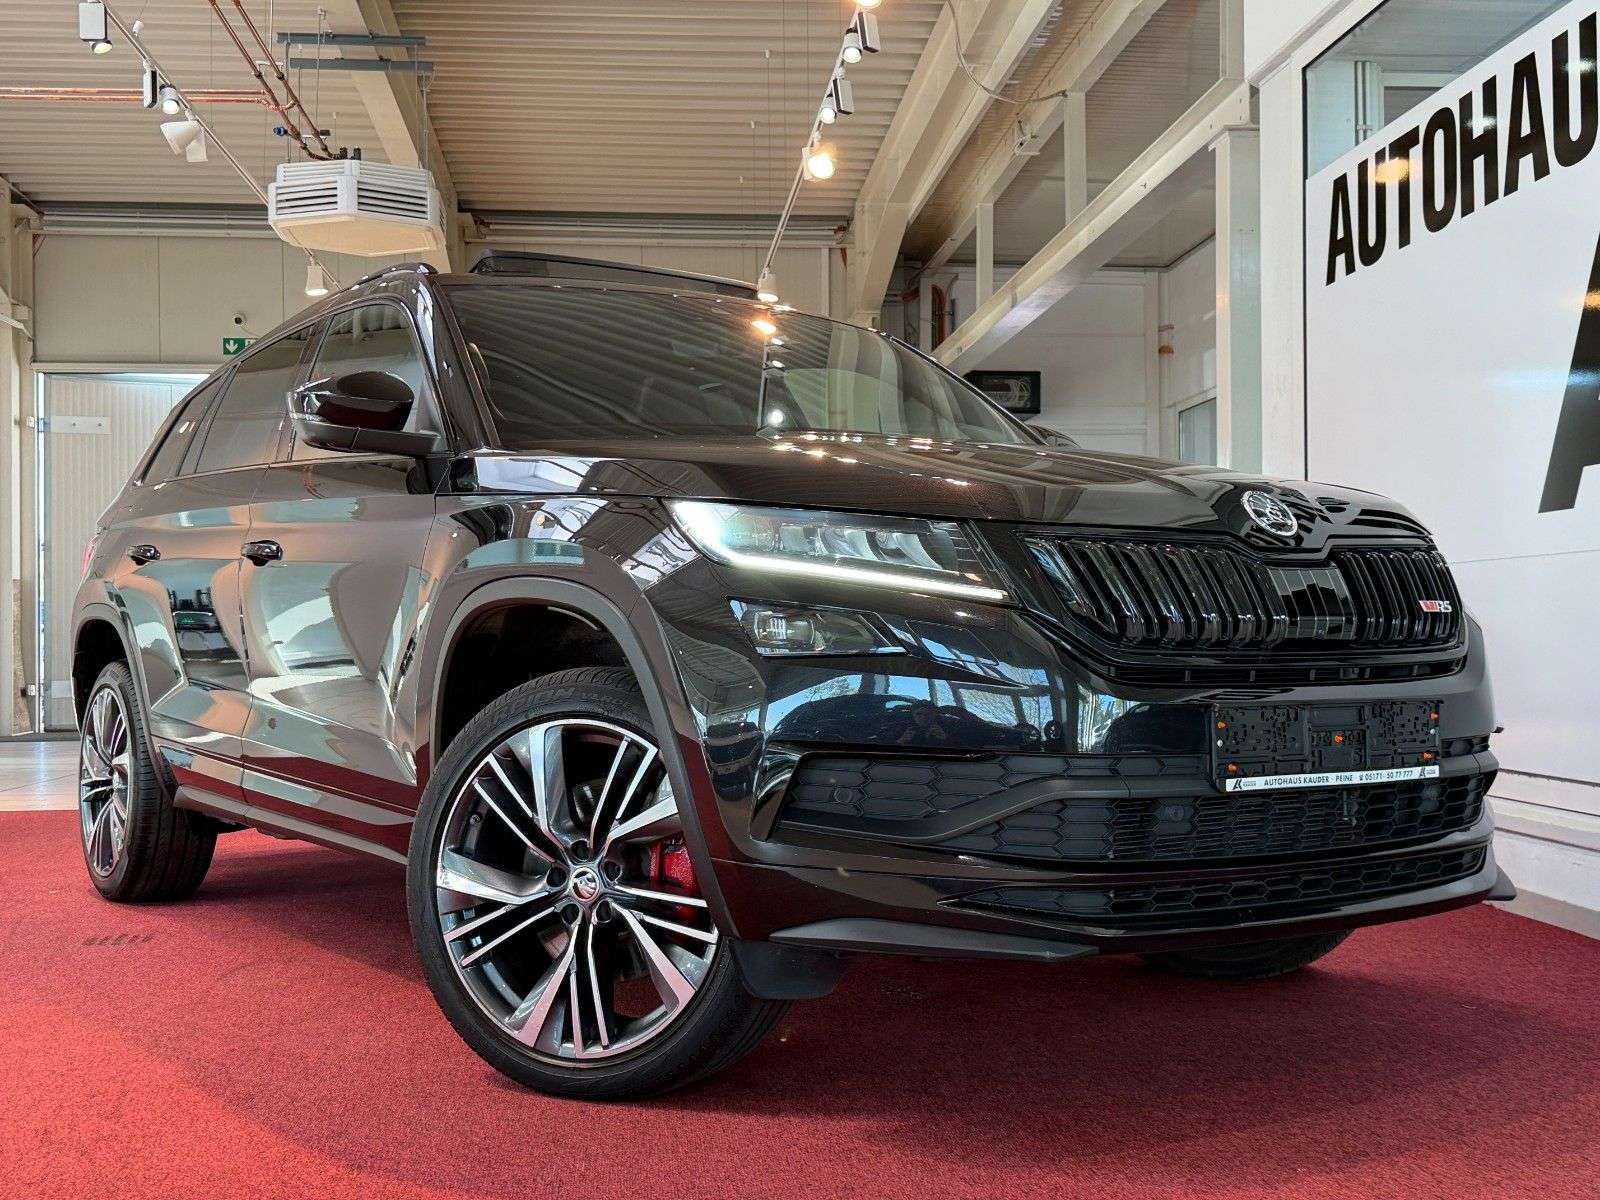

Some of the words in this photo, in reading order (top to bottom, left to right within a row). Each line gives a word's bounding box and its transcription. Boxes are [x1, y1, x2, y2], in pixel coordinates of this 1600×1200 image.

[1264, 776, 1302, 786] AUTOHAUS
[1303, 775, 1330, 784] KAUDER
[1335, 774, 1353, 782] PEINE
